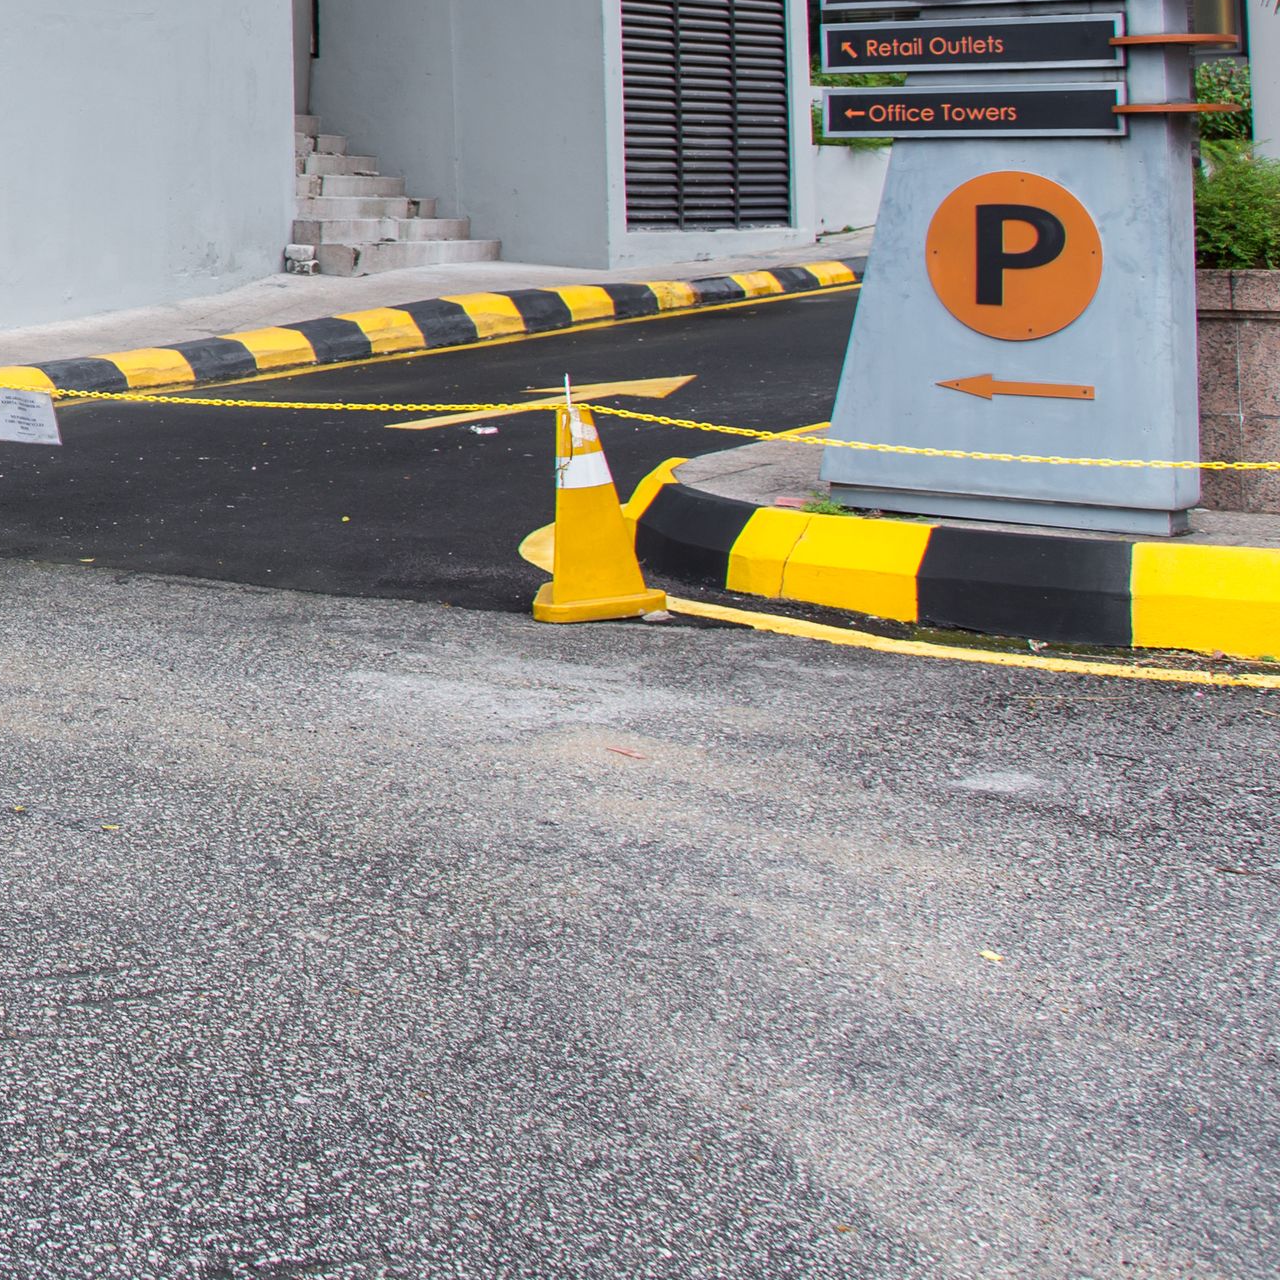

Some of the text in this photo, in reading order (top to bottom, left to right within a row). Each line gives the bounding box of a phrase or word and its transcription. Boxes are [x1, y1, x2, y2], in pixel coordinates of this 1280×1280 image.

[866, 36, 1004, 57] Retail Outlets
[868, 102, 1018, 123] Office Towers
[975, 203, 1067, 307] P
